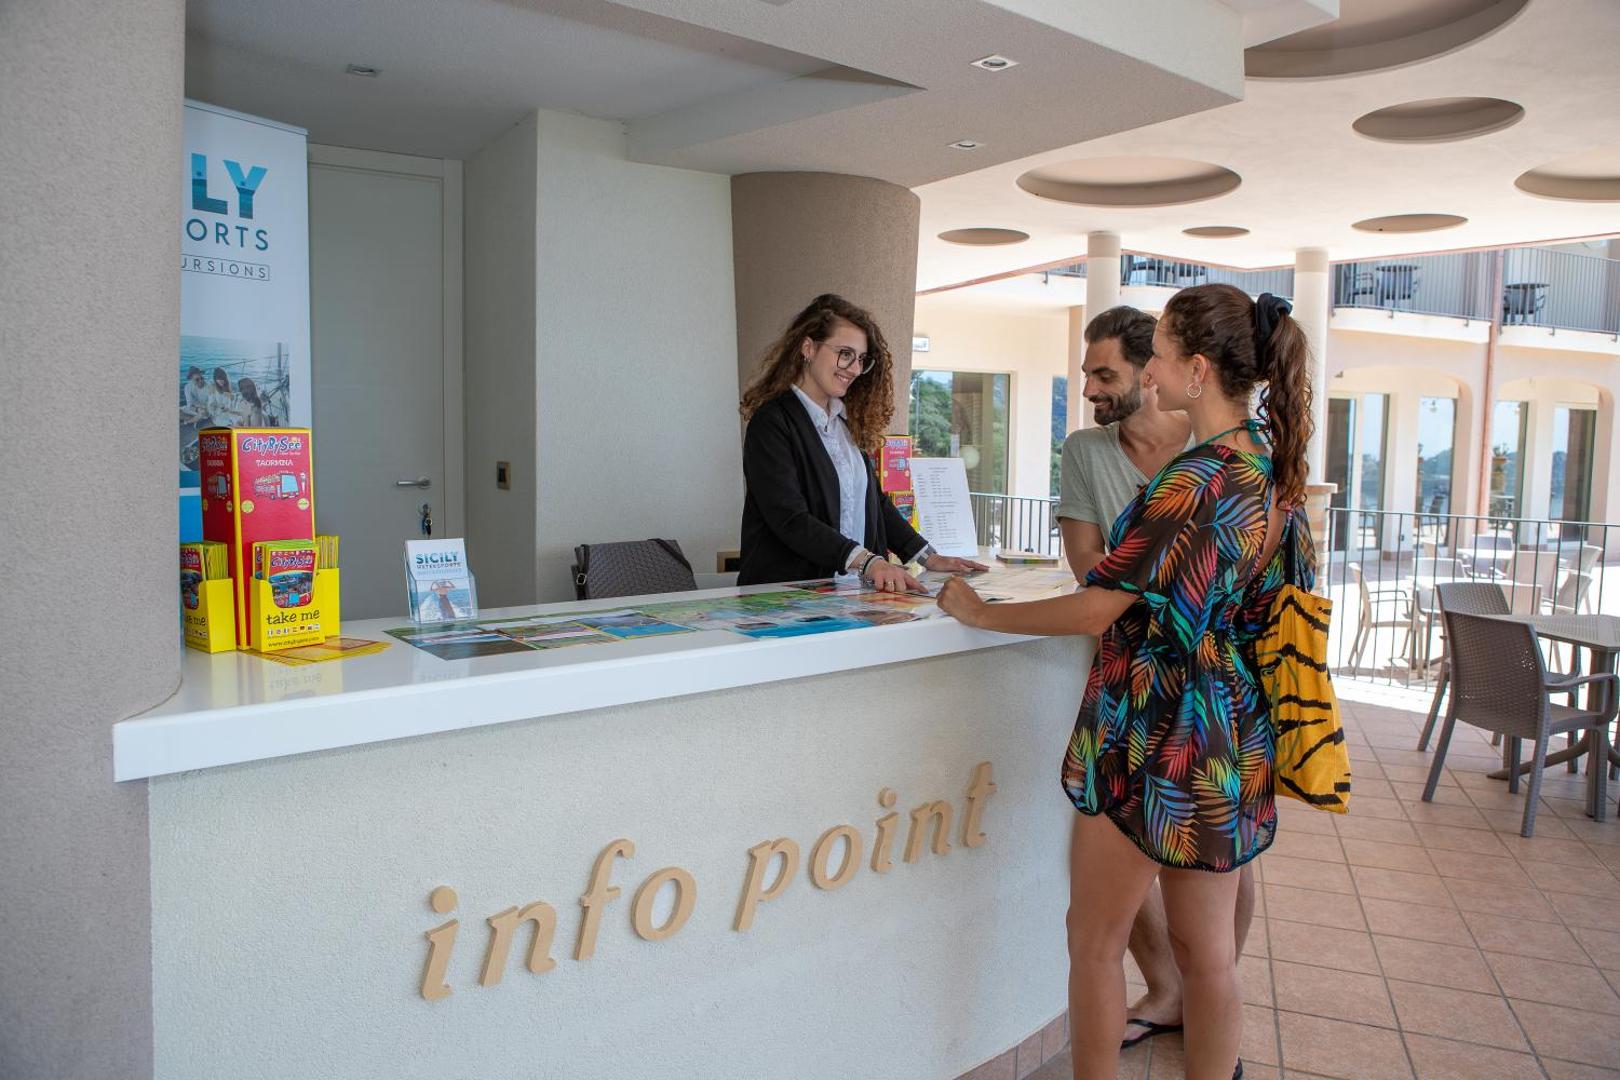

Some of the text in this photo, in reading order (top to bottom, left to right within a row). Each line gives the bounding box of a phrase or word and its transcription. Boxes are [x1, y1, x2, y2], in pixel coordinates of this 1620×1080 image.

[242, 435, 302, 456] CityBySee
[415, 551, 458, 565] SICILY
[266, 609, 320, 625] take me
[419, 761, 997, 1001] info point
